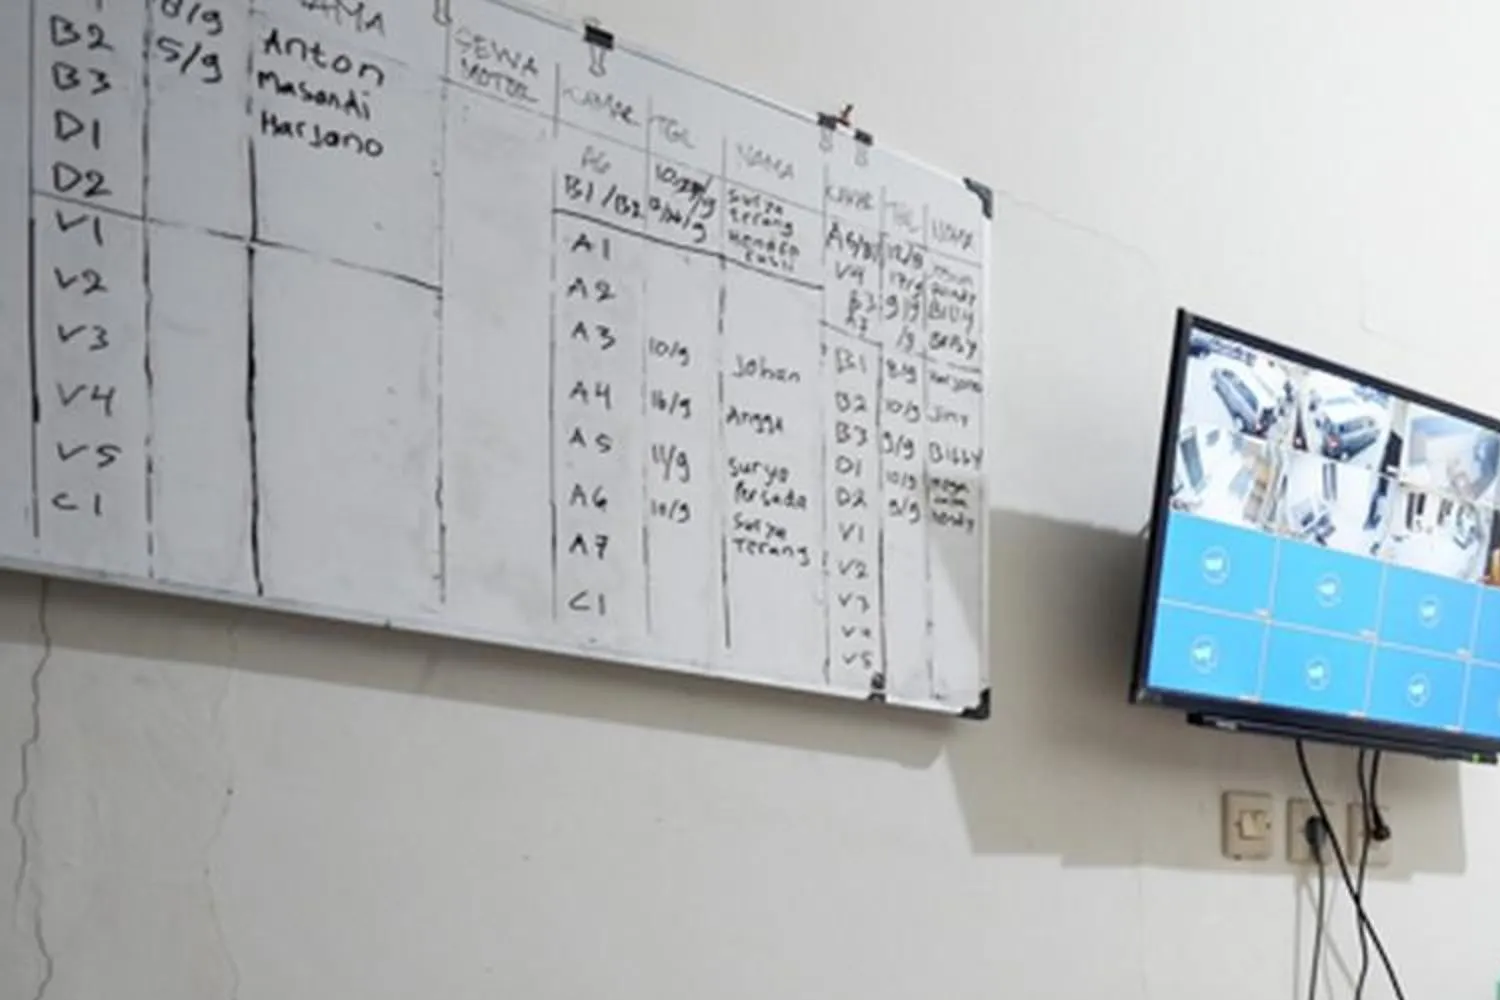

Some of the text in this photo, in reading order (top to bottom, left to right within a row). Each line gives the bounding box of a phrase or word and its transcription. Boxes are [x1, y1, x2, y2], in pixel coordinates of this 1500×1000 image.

[50, 14, 115, 51] B2
[262, 28, 384, 87] Anton
[52, 61, 112, 94] B3
[54, 109, 100, 150] D1
[53, 161, 112, 197] D2
[56, 210, 103, 246] V1
[571, 234, 610, 260] A1
[54, 267, 108, 295] V2
[566, 278, 616, 302] A2
[57, 324, 109, 351] V3
[571, 322, 616, 350] A3
[55, 381, 116, 417] V4
[569, 381, 610, 410] A4
[835, 391, 867, 413] B2
[569, 427, 612, 453] A5
[835, 421, 868, 447] B3
[56, 442, 122, 468] V5
[51, 493, 102, 516] C1
[569, 590, 606, 615] C1
